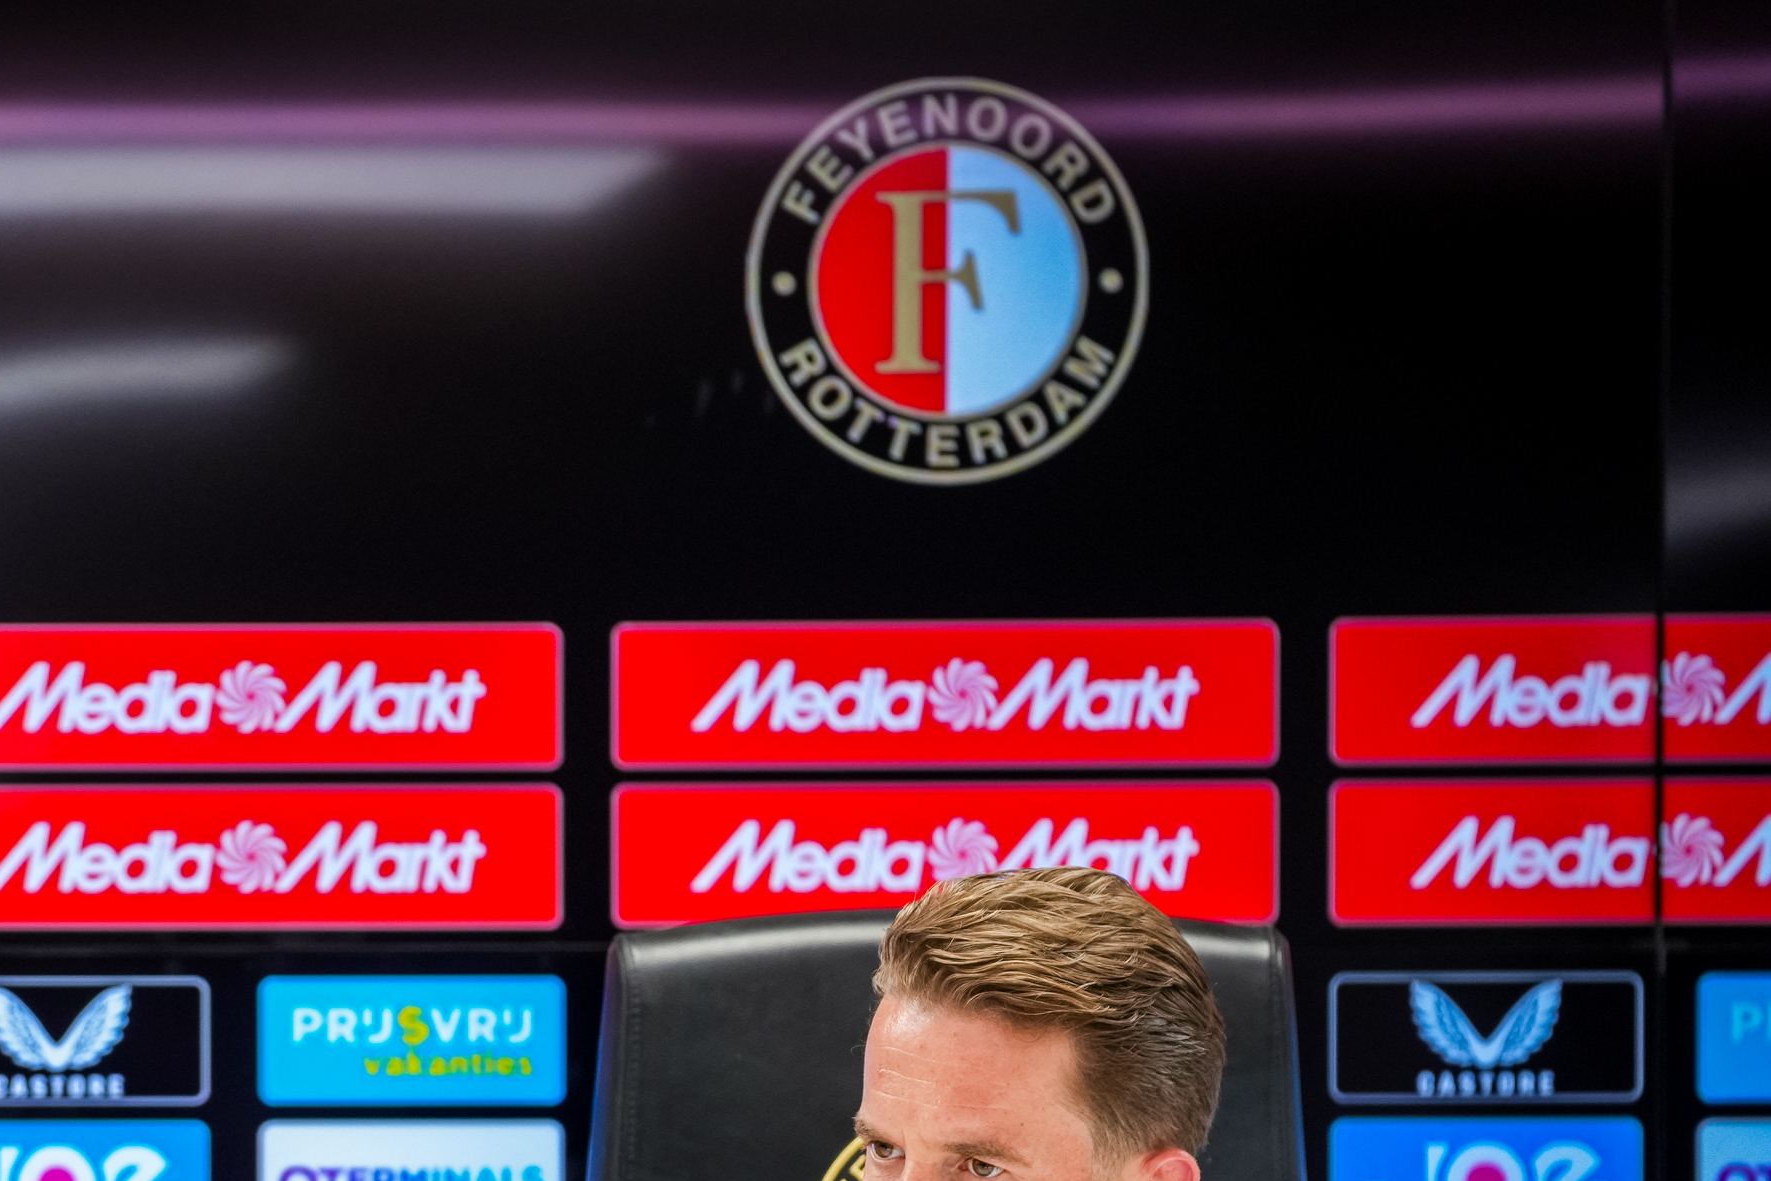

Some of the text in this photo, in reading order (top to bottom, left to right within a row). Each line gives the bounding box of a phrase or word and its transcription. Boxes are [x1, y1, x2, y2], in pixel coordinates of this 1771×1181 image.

[782, 93, 1116, 224] FEYENOORD
[874, 190, 1022, 374] F
[778, 334, 1116, 468] ROTTERDAM
[274, 660, 487, 734] Markt
[690, 656, 1200, 733] Media Markt
[1410, 653, 1652, 729] Media
[274, 820, 487, 895] Markt
[690, 818, 928, 893] Media
[1410, 814, 1651, 890] Media
[1415, 1069, 1556, 1097] CASTORE
